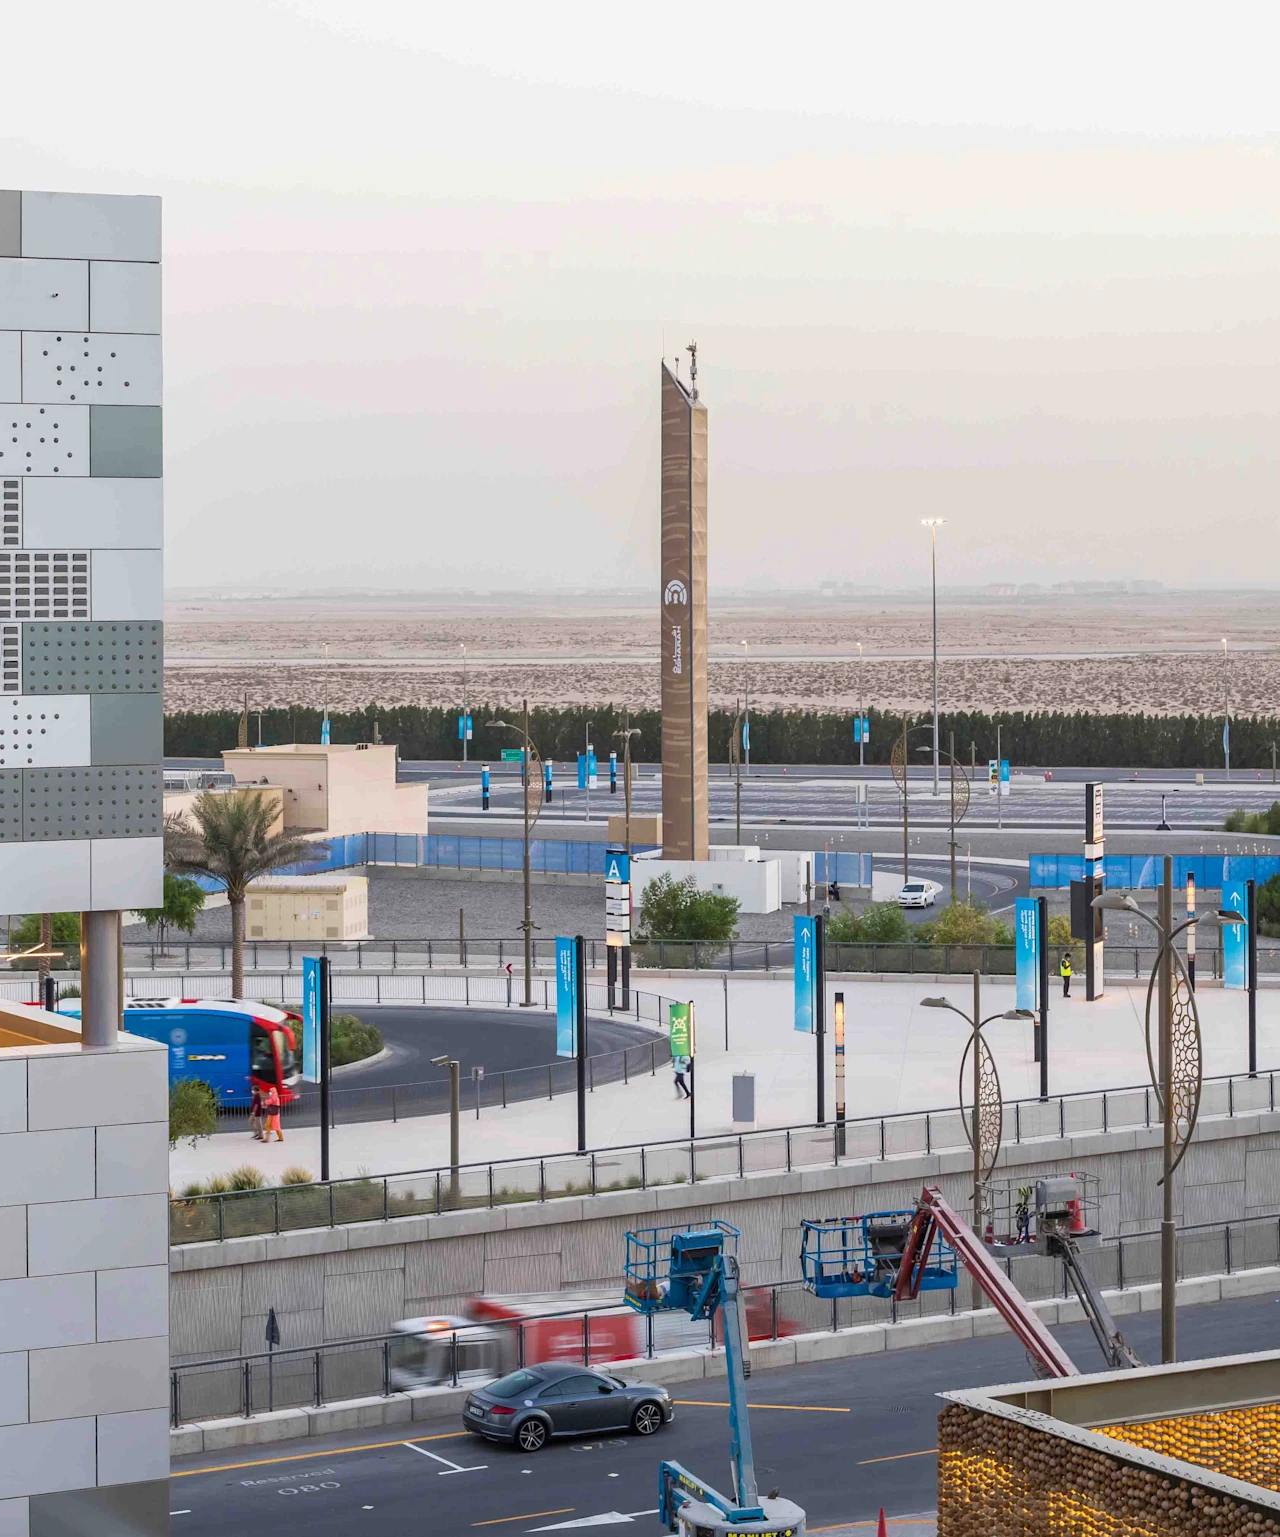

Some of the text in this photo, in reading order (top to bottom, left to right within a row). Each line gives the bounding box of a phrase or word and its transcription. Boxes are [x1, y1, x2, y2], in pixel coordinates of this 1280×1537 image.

[608, 859, 620, 877] A
[240, 1468, 336, 1487] Reserved
[278, 1481, 341, 1495] 080
